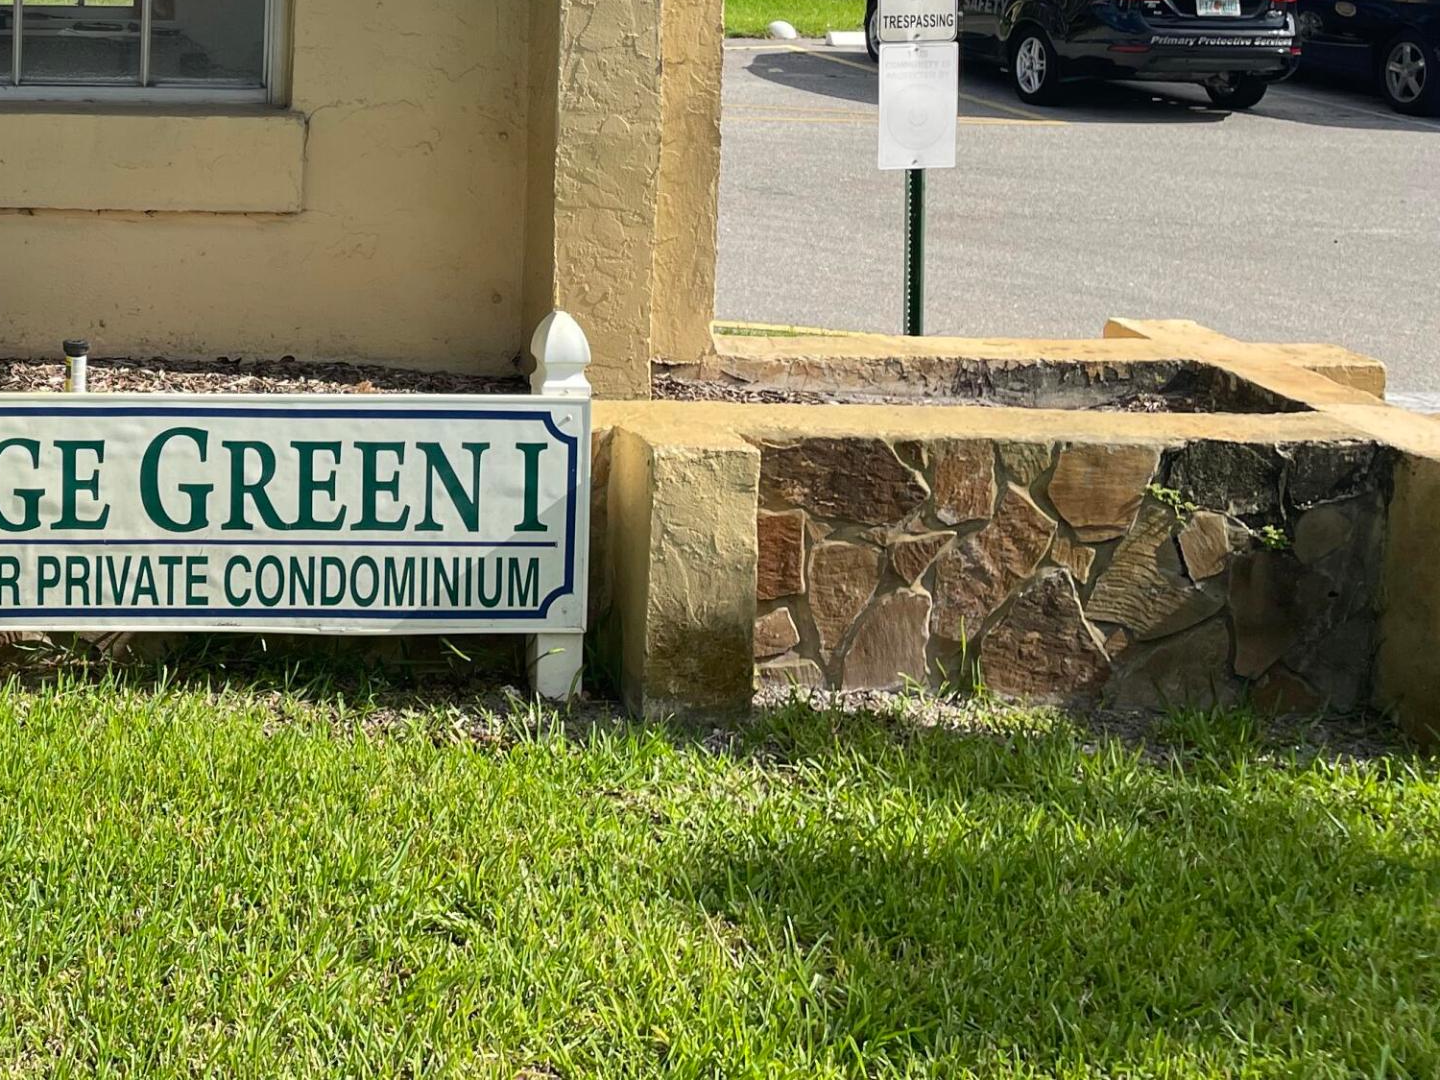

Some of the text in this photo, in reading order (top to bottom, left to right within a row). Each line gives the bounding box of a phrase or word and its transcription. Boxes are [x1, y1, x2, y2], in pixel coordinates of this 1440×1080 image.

[882, 12, 954, 29] TRESPASSING
[1151, 35, 1197, 47] Primary
[1198, 36, 1252, 46] Protective
[140, 427, 490, 533] GREEN
[513, 442, 549, 533] I
[36, 555, 209, 608] PRIVATE
[223, 555, 541, 609] CONDOMINIUM
